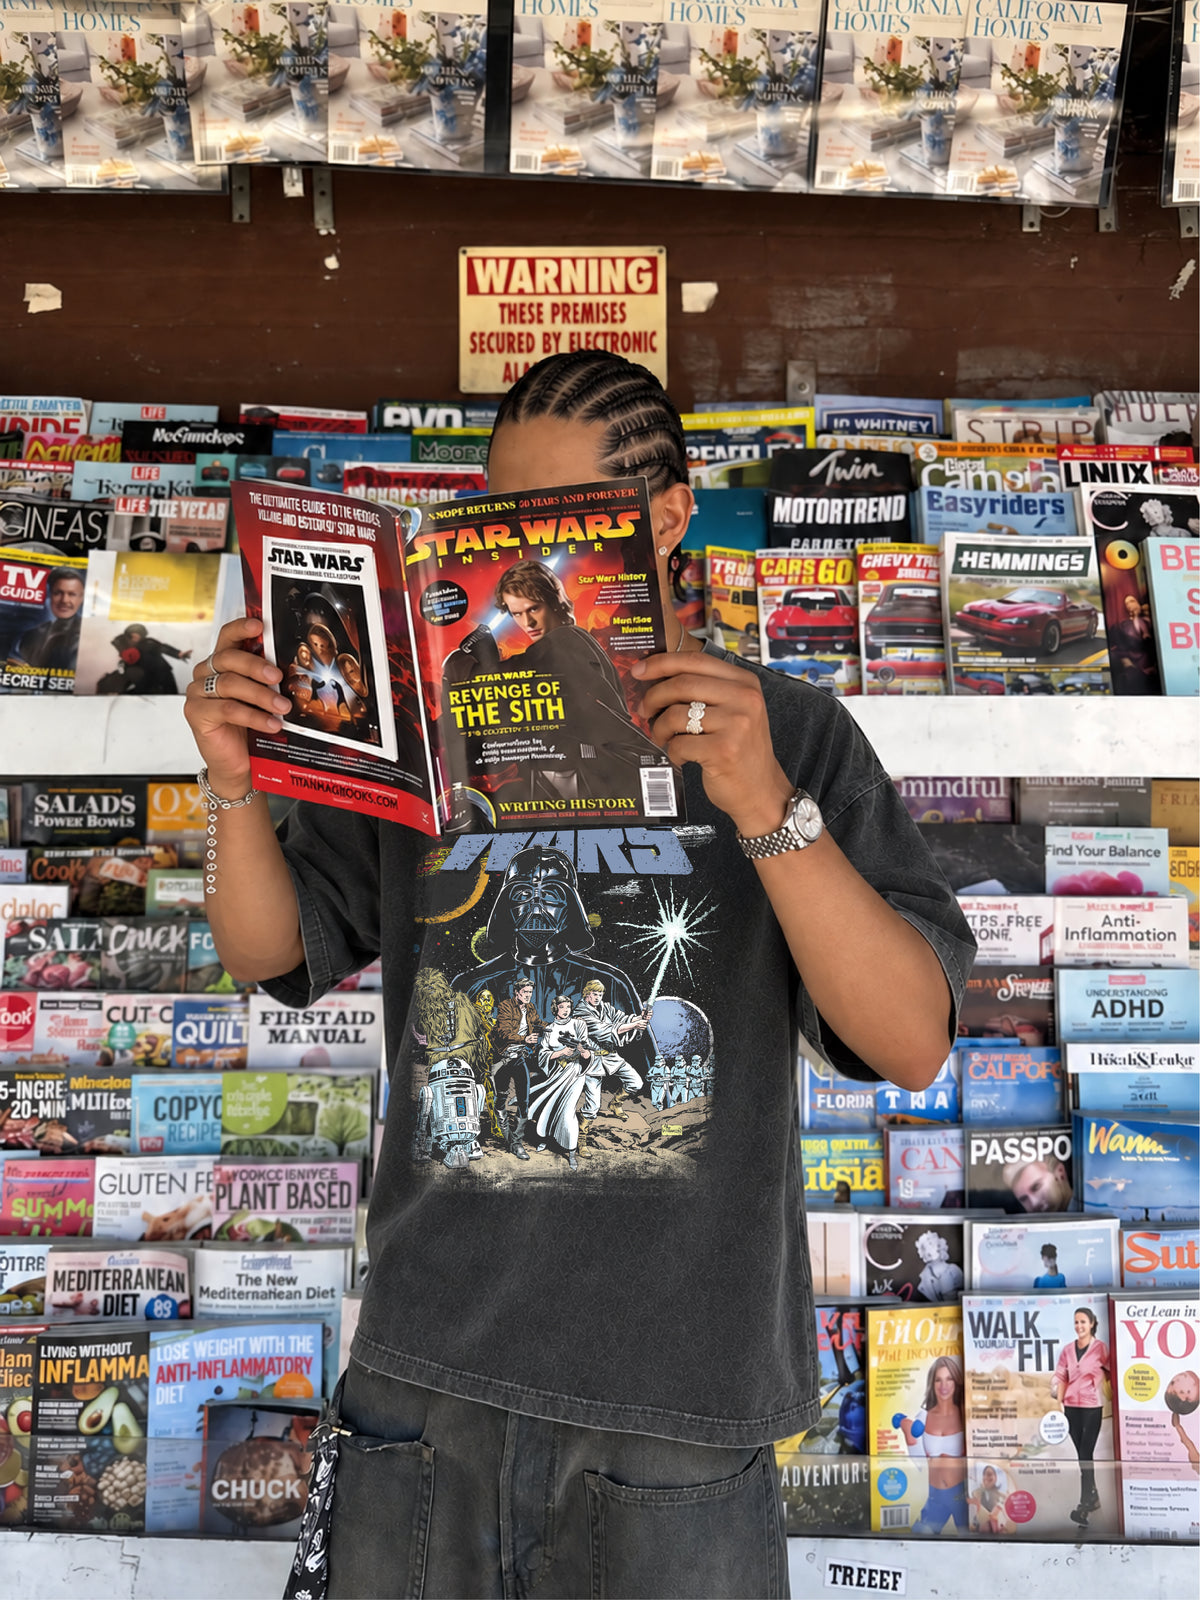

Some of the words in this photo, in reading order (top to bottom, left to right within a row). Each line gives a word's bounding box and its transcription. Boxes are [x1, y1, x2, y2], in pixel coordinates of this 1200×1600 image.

[521, 0, 599, 18] HOMES
[669, 2, 746, 26] HOMES
[976, 0, 1104, 25] CALIFORNIA
[63, 12, 141, 32] HOMES
[833, 12, 911, 33] HOMES
[973, 17, 1050, 41] HOMES
[472, 257, 653, 294] WARNING
[499, 302, 544, 324] THESE
[551, 302, 627, 324] PREMISES
[470, 332, 535, 354] SECURED
[542, 332, 562, 353] BY
[569, 331, 657, 353] ELECTRONIC
[142, 407, 165, 419] LIFE
[855, 417, 930, 434] WHITNEY
[133, 467, 159, 480] LIFE
[808, 449, 884, 487] Twin
[586, 487, 639, 501] FOREVER!
[927, 490, 1065, 518] Easyriders
[117, 498, 147, 513] LIFE
[773, 494, 906, 525] MOTORTREND
[406, 522, 521, 567] STAR
[519, 511, 641, 546] WARS
[268, 547, 308, 568] STAR
[310, 552, 364, 573] WARS
[438, 542, 603, 569] INSIDER
[861, 554, 911, 569] CHEVY
[958, 550, 1084, 572] HEMMINGS
[3, 564, 46, 590] TV
[761, 558, 815, 577] CARS
[0, 585, 44, 602] GUIDE
[472, 672, 502, 684] STAR
[503, 670, 537, 681] WARS
[449, 682, 532, 706] REVENGE
[537, 681, 561, 696] OF
[450, 702, 501, 729] THE
[510, 697, 566, 724] SITH
[34, 795, 137, 815] SALADS
[499, 799, 566, 813] WRITING
[570, 798, 637, 811] HISTORY
[1045, 844, 1073, 858] Find
[1076, 845, 1105, 859] Your
[1108, 845, 1162, 859] Balance
[1101, 914, 1141, 929] Anti-
[1065, 926, 1177, 942] Inflammation
[259, 1011, 331, 1026] FIRST
[332, 1011, 376, 1026] AID
[1091, 999, 1165, 1020] ADHD
[268, 1029, 367, 1045] MANUAL
[970, 1135, 1073, 1166] PASSPO
[99, 1171, 188, 1196] GLUTEN
[215, 1181, 280, 1211] PLANT
[287, 1181, 351, 1210] BASED
[53, 1267, 186, 1294] MEDITERRANEAN
[235, 1274, 263, 1287] The
[266, 1274, 298, 1287] New
[306, 1286, 336, 1300] Diet
[103, 1293, 141, 1317] DIET
[1126, 1304, 1149, 1318] Get
[1151, 1306, 1180, 1318] Lean
[1184, 1305, 1197, 1318] in
[968, 1310, 1041, 1340] WALK
[40, 1343, 77, 1359] LIVING
[78, 1341, 133, 1358] WITHOUT
[157, 1341, 190, 1363] LOSE
[193, 1336, 247, 1359] WEIGHT
[249, 1335, 286, 1356] WITH
[288, 1334, 315, 1354] THE
[1120, 1318, 1200, 1361] YO
[1017, 1339, 1060, 1373] FIT
[155, 1356, 313, 1385] ANTI-INFLAMMATORY
[156, 1384, 186, 1406] DIET
[211, 1479, 302, 1501] CHUCK
